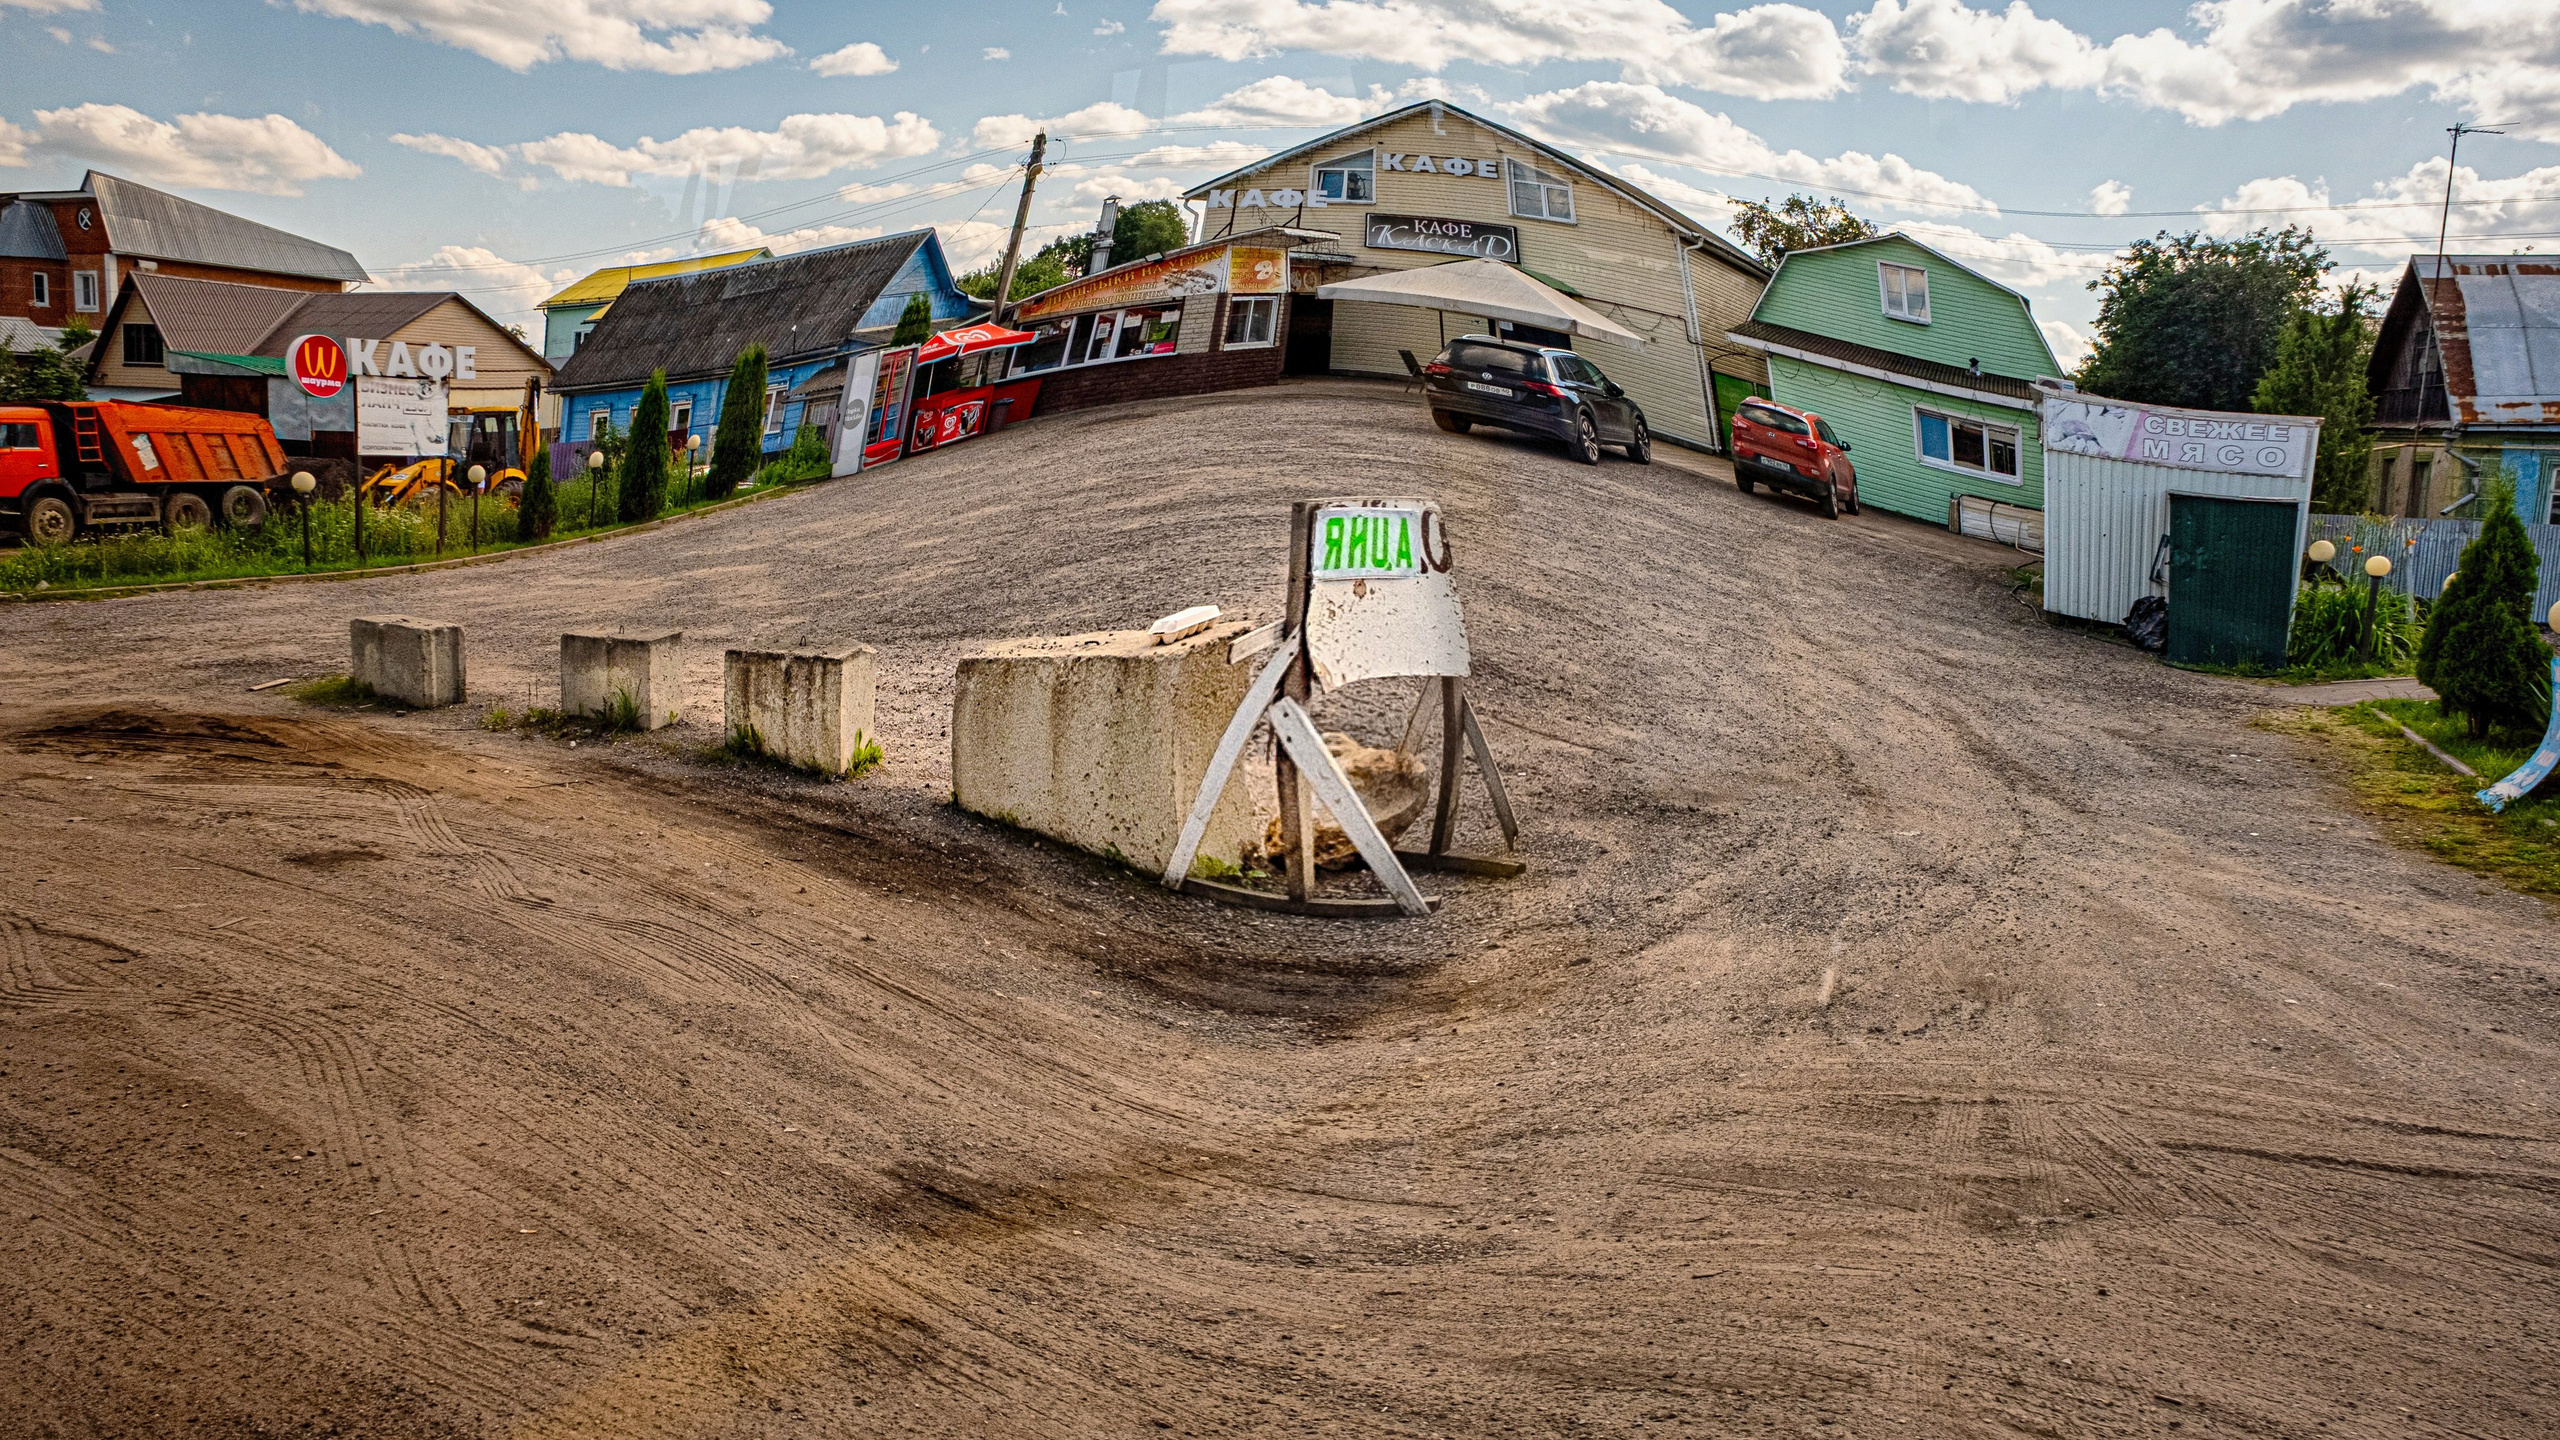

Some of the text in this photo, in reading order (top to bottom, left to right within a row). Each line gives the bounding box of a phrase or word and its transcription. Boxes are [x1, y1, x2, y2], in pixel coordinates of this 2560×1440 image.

[1381, 153, 1499, 179] КАФЕ
[1207, 188, 1328, 208] КАФЕ
[1414, 220, 1472, 238] КАФЕ
[1141, 265, 1163, 277] НА
[347, 338, 476, 382] КАФЕ
[301, 376, 342, 388] шаурма
[2142, 415, 2291, 442] СВЕЖЕЕ
[2142, 438, 2286, 467] МЯСО
